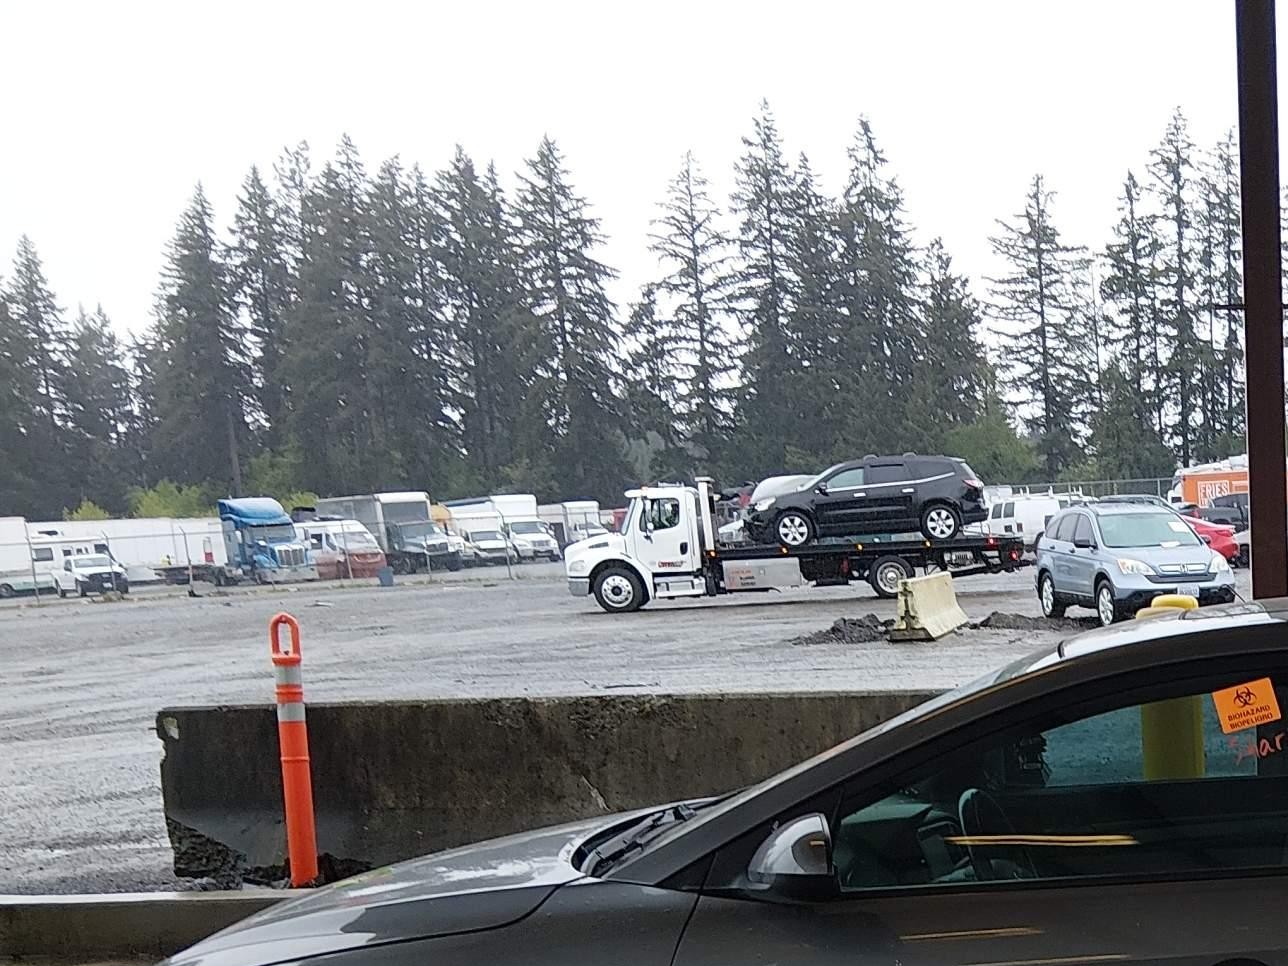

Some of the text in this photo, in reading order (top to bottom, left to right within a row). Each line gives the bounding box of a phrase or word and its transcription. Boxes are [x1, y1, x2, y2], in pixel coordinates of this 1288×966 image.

[1199, 483, 1229, 500] FRIES
[1227, 704, 1271, 722] BIOHAZARD
[1229, 712, 1274, 730] BIOPELIGRO
